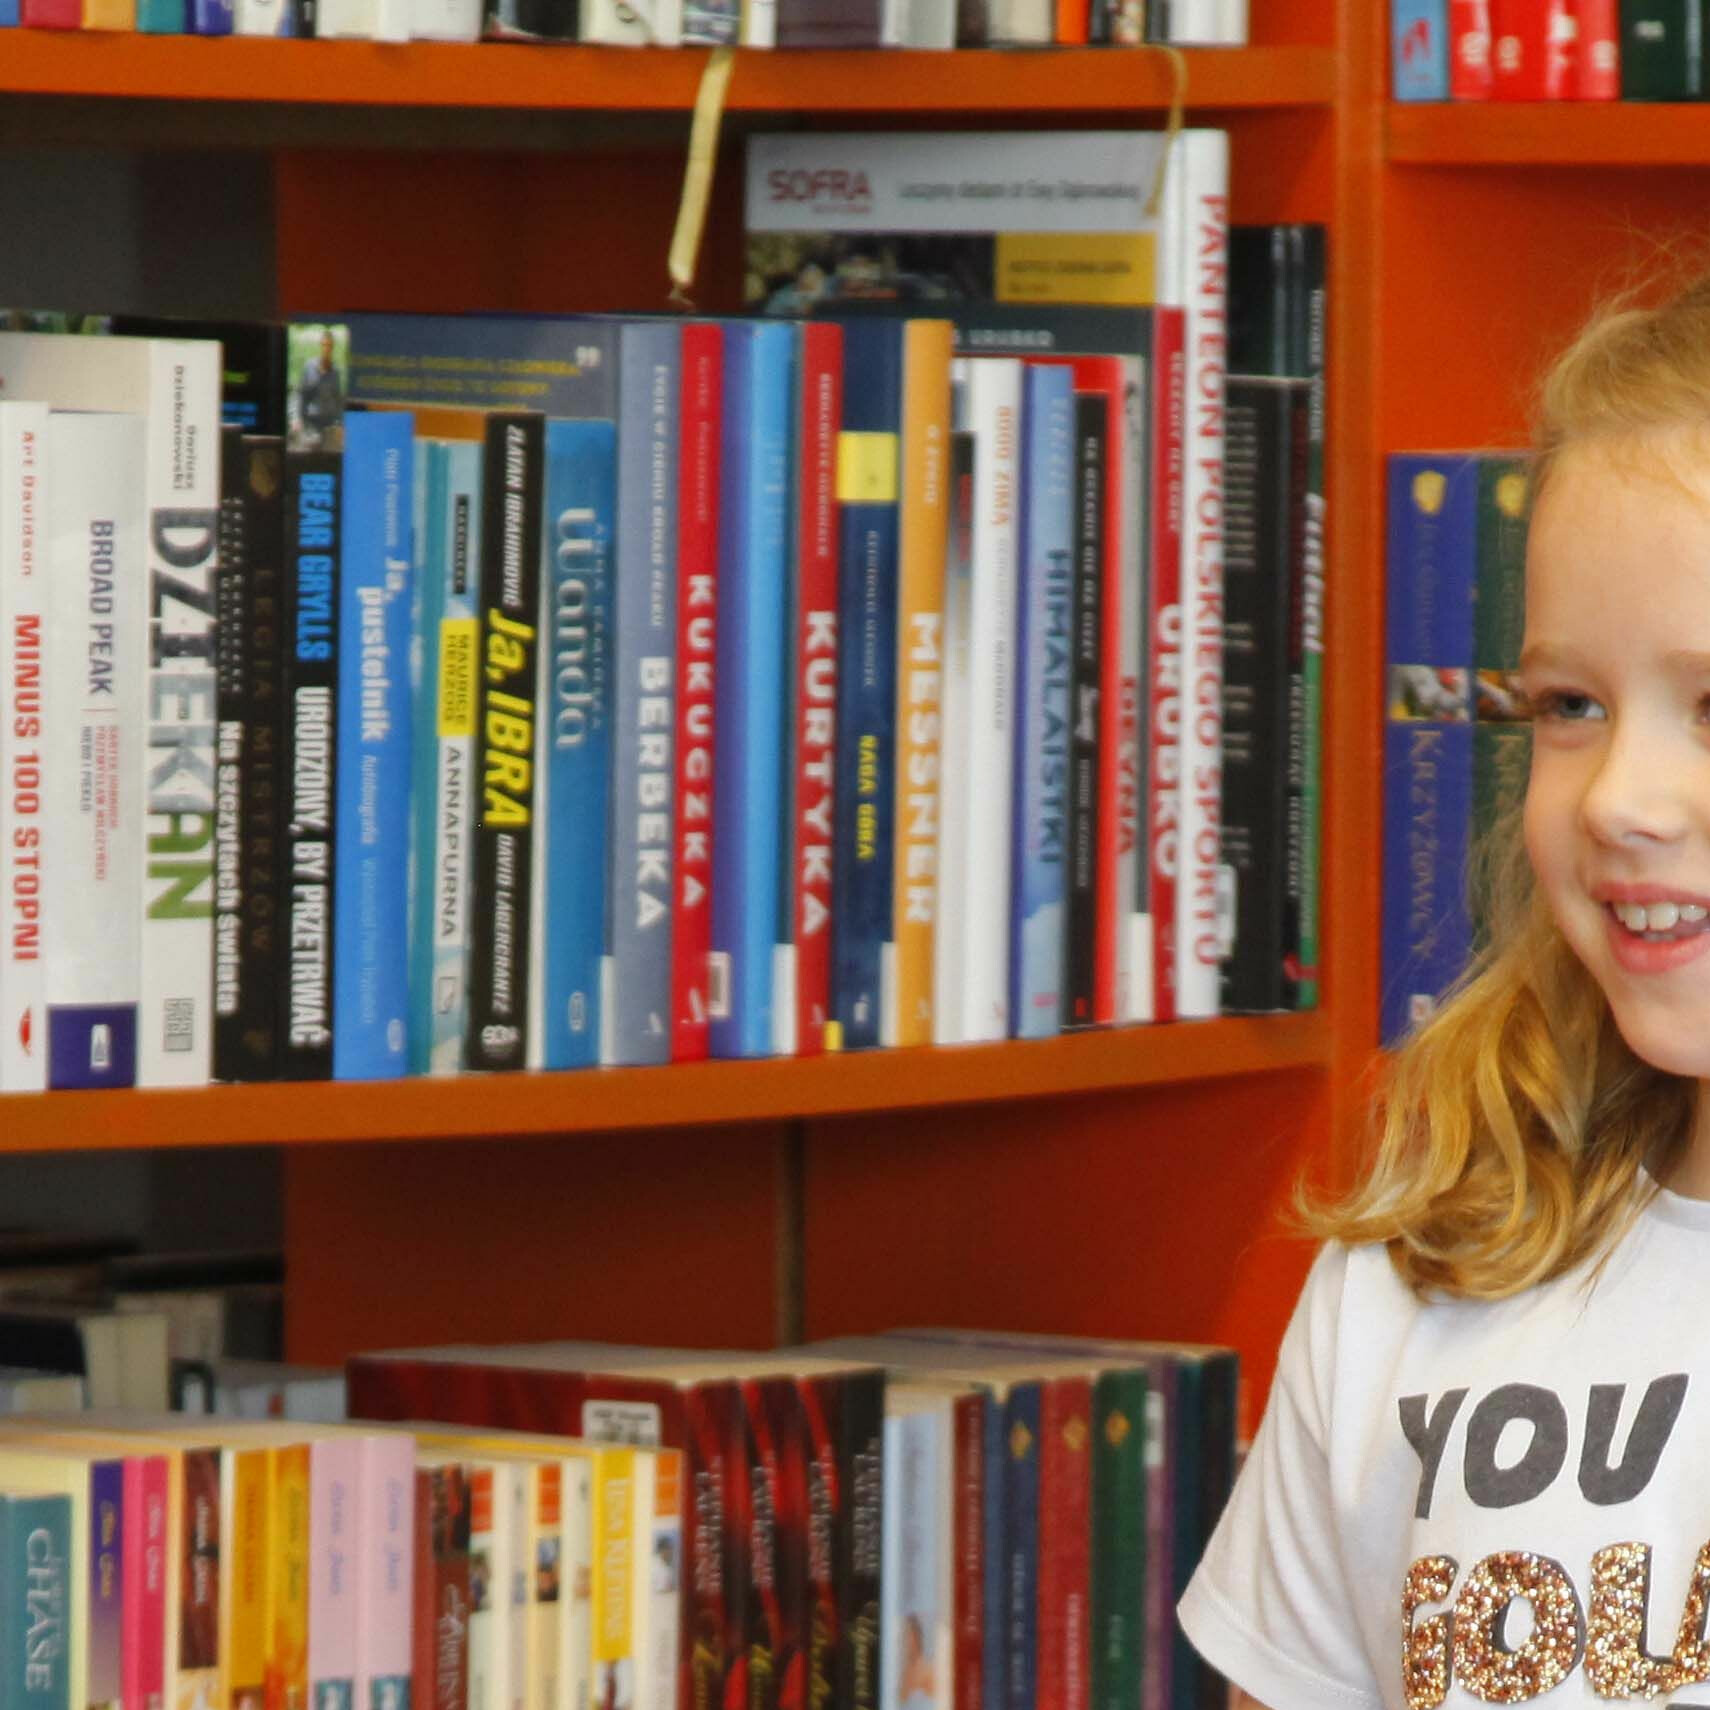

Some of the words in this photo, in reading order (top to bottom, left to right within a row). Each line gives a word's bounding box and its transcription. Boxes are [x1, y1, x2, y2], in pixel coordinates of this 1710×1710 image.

[1198, 192, 1226, 438] PANTEON
[22, 432, 36, 467] Art
[298, 473, 336, 547] BEAR
[503, 424, 526, 488] ZLATAN
[21, 475, 36, 577] Davidson
[88, 520, 114, 615] BROAD
[88, 623, 114, 696] PEAK
[296, 554, 335, 660] GRYLLS
[354, 586, 393, 744] pustelnik
[555, 507, 597, 750] Wanda
[1195, 457, 1223, 747] POLSKIEGO
[13, 614, 41, 738] MINUS
[146, 507, 218, 921] DZIEKAN
[218, 720, 244, 758] Na
[442, 634, 456, 723] HERZOG
[454, 634, 468, 726] MAURICE
[682, 574, 713, 908] KUKUCZKA
[1040, 549, 1073, 864] HIMALAISTKI
[12, 753, 41, 815] 100
[289, 686, 332, 834] URODZONY,
[484, 690, 535, 828] IBRA
[635, 657, 670, 930] BERBEKA
[802, 610, 837, 937] KURTYKA
[906, 612, 943, 925] MESSNER
[12, 826, 41, 962] STOPNI
[214, 764, 242, 911] szczytach
[291, 842, 330, 878] BY
[439, 746, 463, 938] ANNAPURNA
[496, 833, 516, 887] DAVID
[1193, 766, 1221, 968] SPORTU
[289, 884, 332, 1046] PRZETRWAĆ
[1398, 1372, 1690, 1520] YOU
[25, 1528, 50, 1692] CHASE
